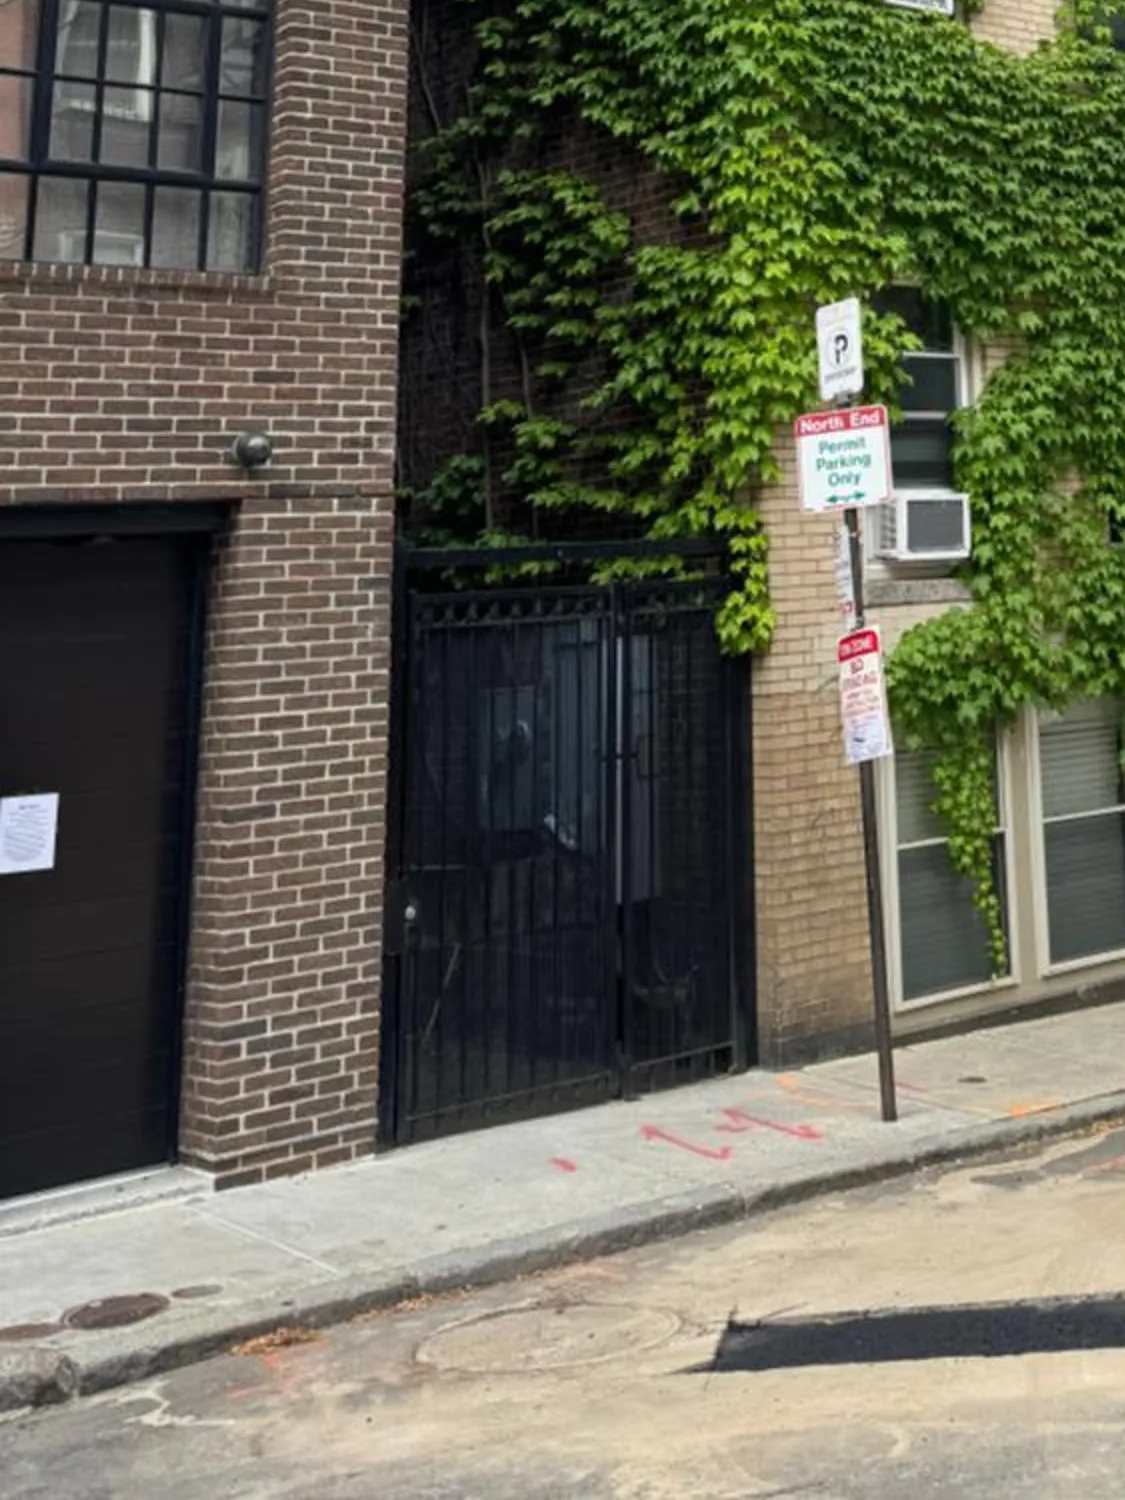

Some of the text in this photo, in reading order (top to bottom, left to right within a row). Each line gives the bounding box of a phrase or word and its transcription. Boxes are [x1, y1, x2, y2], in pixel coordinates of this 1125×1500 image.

[800, 409, 880, 433] North End
[818, 437, 866, 454] Permit
[816, 454, 871, 472] Parking
[828, 471, 861, 487] Only
